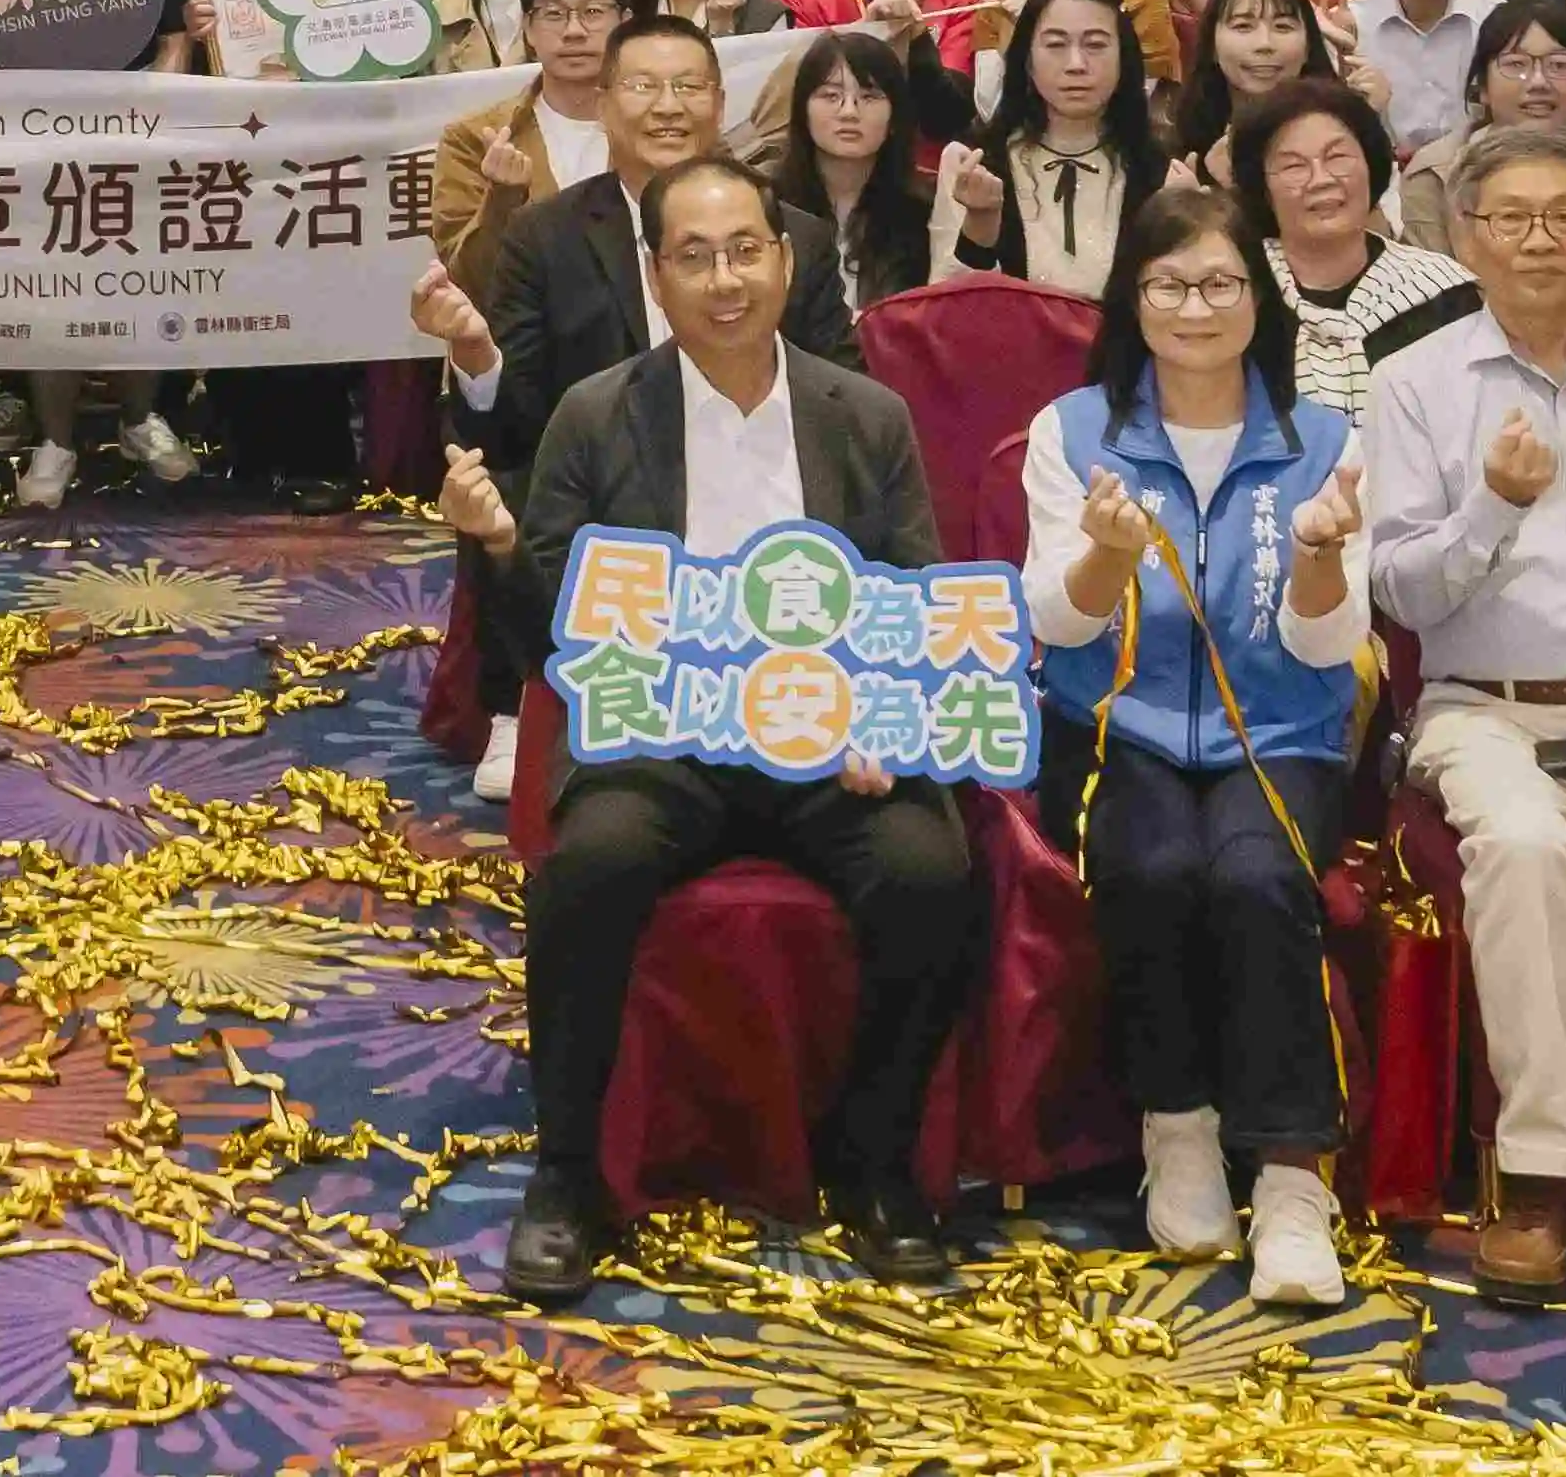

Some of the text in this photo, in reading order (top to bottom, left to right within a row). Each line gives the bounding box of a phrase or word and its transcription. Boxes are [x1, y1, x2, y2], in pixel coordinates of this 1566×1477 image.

[41, 1, 93, 26] TUNG
[20, 106, 165, 139] County
[95, 269, 226, 297] COUNTY
[65, 321, 130, 338] 主辦單位
[194, 314, 291, 334] 雲林縣衛生局
[570, 542, 1019, 672] 民以食為天
[562, 647, 1027, 772] 食以安為先
